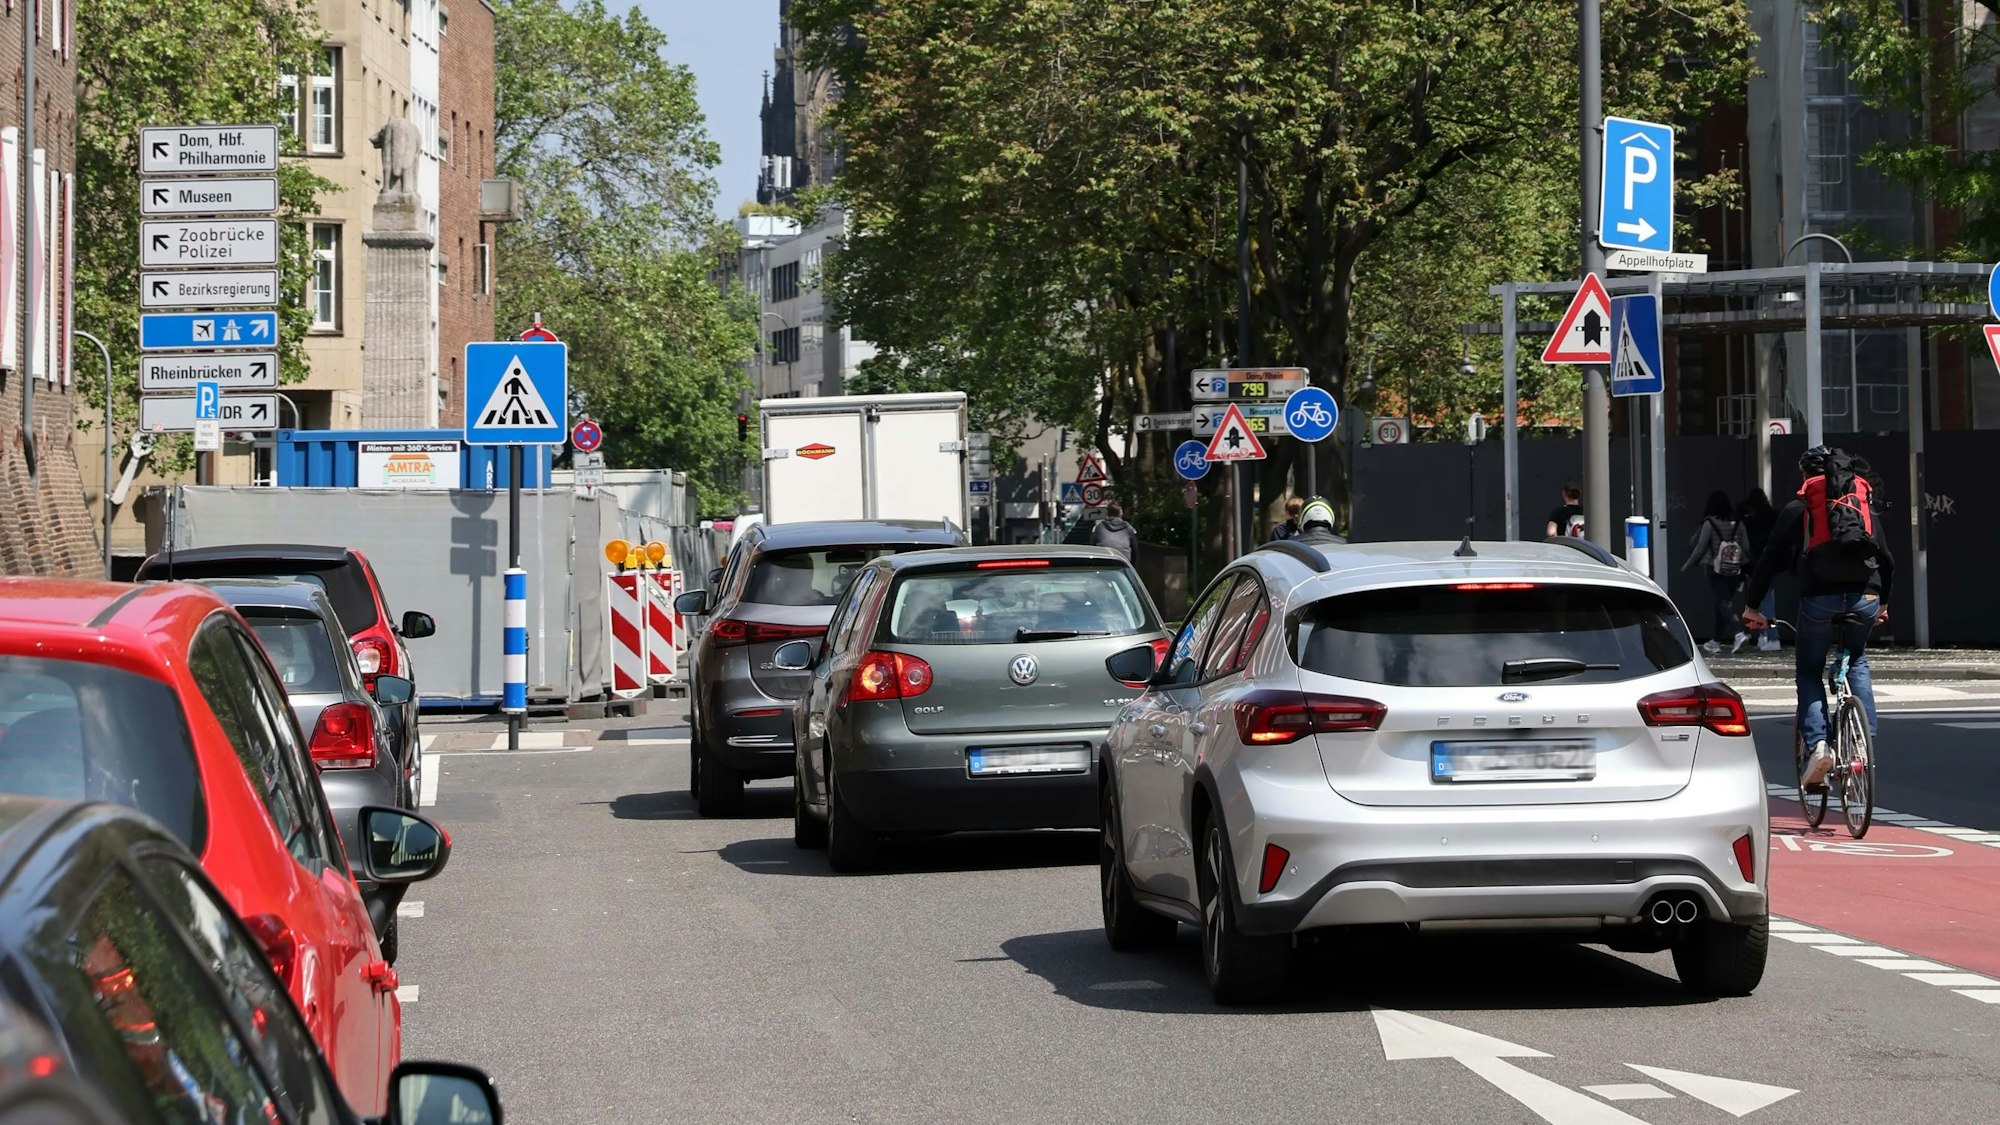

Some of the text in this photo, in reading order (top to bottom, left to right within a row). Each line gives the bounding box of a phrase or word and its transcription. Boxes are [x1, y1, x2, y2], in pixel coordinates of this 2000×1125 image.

[179, 132, 245, 149] Dom, Hbf.
[179, 149, 266, 165] Philharmonie
[179, 189, 232, 204] Museen
[179, 227, 265, 242] Zoobrücke
[179, 244, 232, 259] Polizei
[1618, 254, 1695, 270] Appellhofplatz
[179, 282, 271, 298] Bezirksregierung
[151, 365, 242, 380] Rheinbrücken
[1246, 371, 1284, 380] Dom/Rhein
[1242, 383, 1265, 396] 799
[219, 405, 242, 420] DR
[1249, 408, 1282, 416] Neumarkt
[1382, 428, 1397, 439] 30
[366, 443, 453, 452] Mieten mit 360°-Service
[388, 462, 431, 473] AMTRA
[1085, 489, 1100, 501] 30
[1503, 692, 1523, 701] Ford
[914, 706, 944, 715] GOLF
[1438, 763, 1445, 771] D
